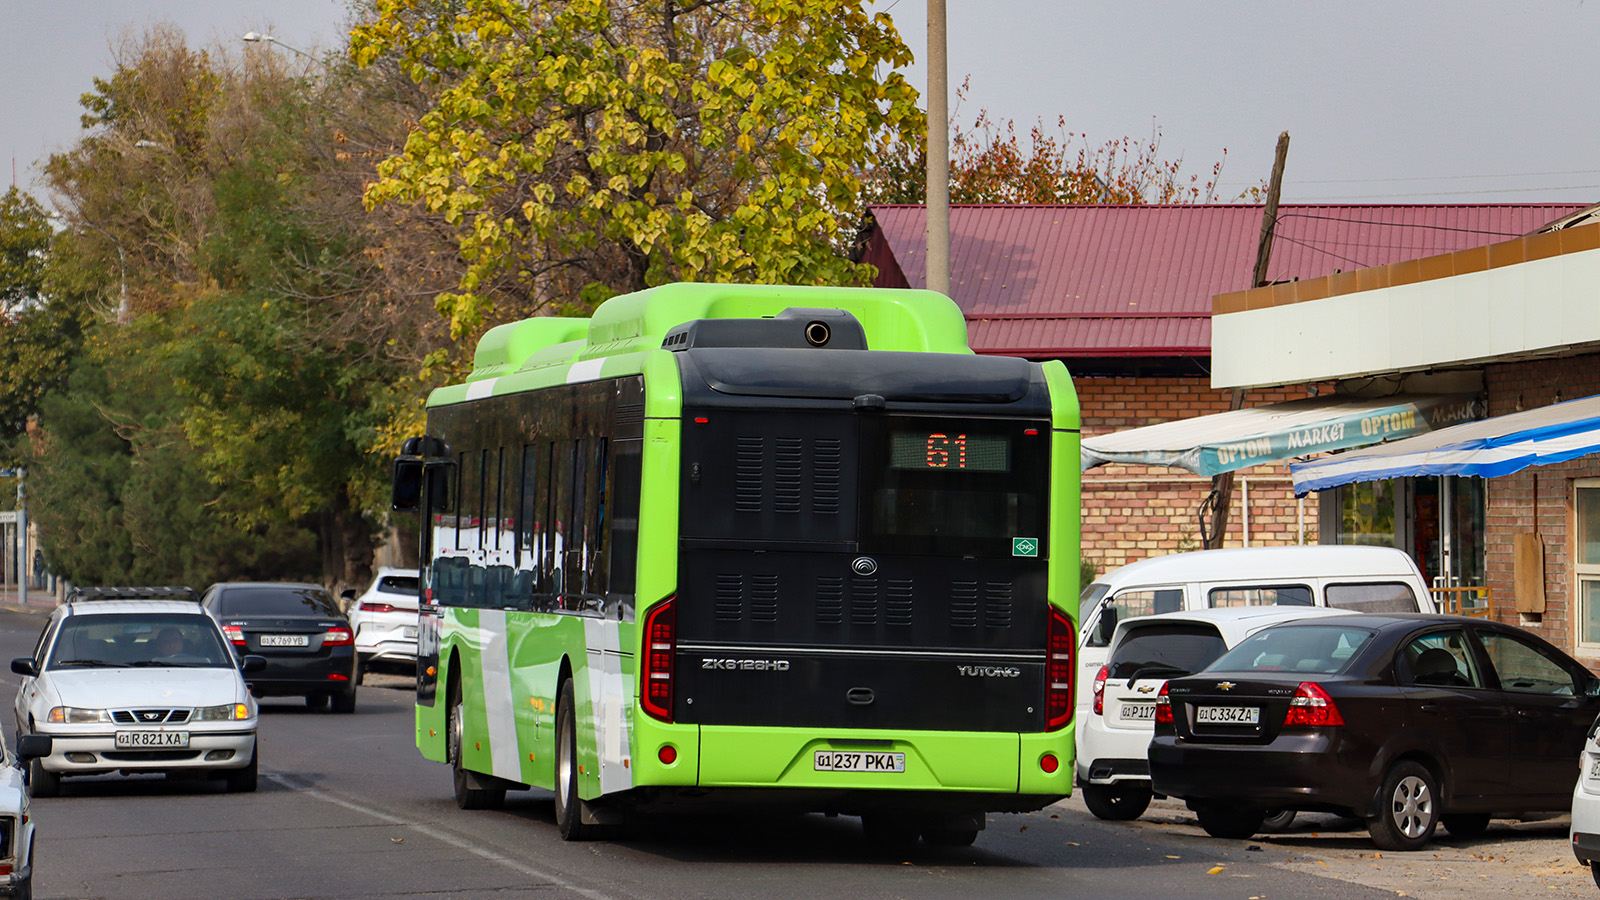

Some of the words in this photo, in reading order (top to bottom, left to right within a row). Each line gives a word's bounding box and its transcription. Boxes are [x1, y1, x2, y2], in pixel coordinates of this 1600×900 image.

[1217, 437, 1272, 465] OPTOM
[1287, 422, 1345, 450] MARKET
[1360, 410, 1416, 437] OPTOM
[927, 433, 966, 468] 61
[957, 665, 1020, 677] YUTONG
[1122, 707, 1131, 717] 01
[1199, 709, 1208, 720] 01
[119, 734, 130, 744] 01
[818, 755, 832, 767] 01
[834, 754, 861, 769] 237
[865, 754, 895, 770] PKA
